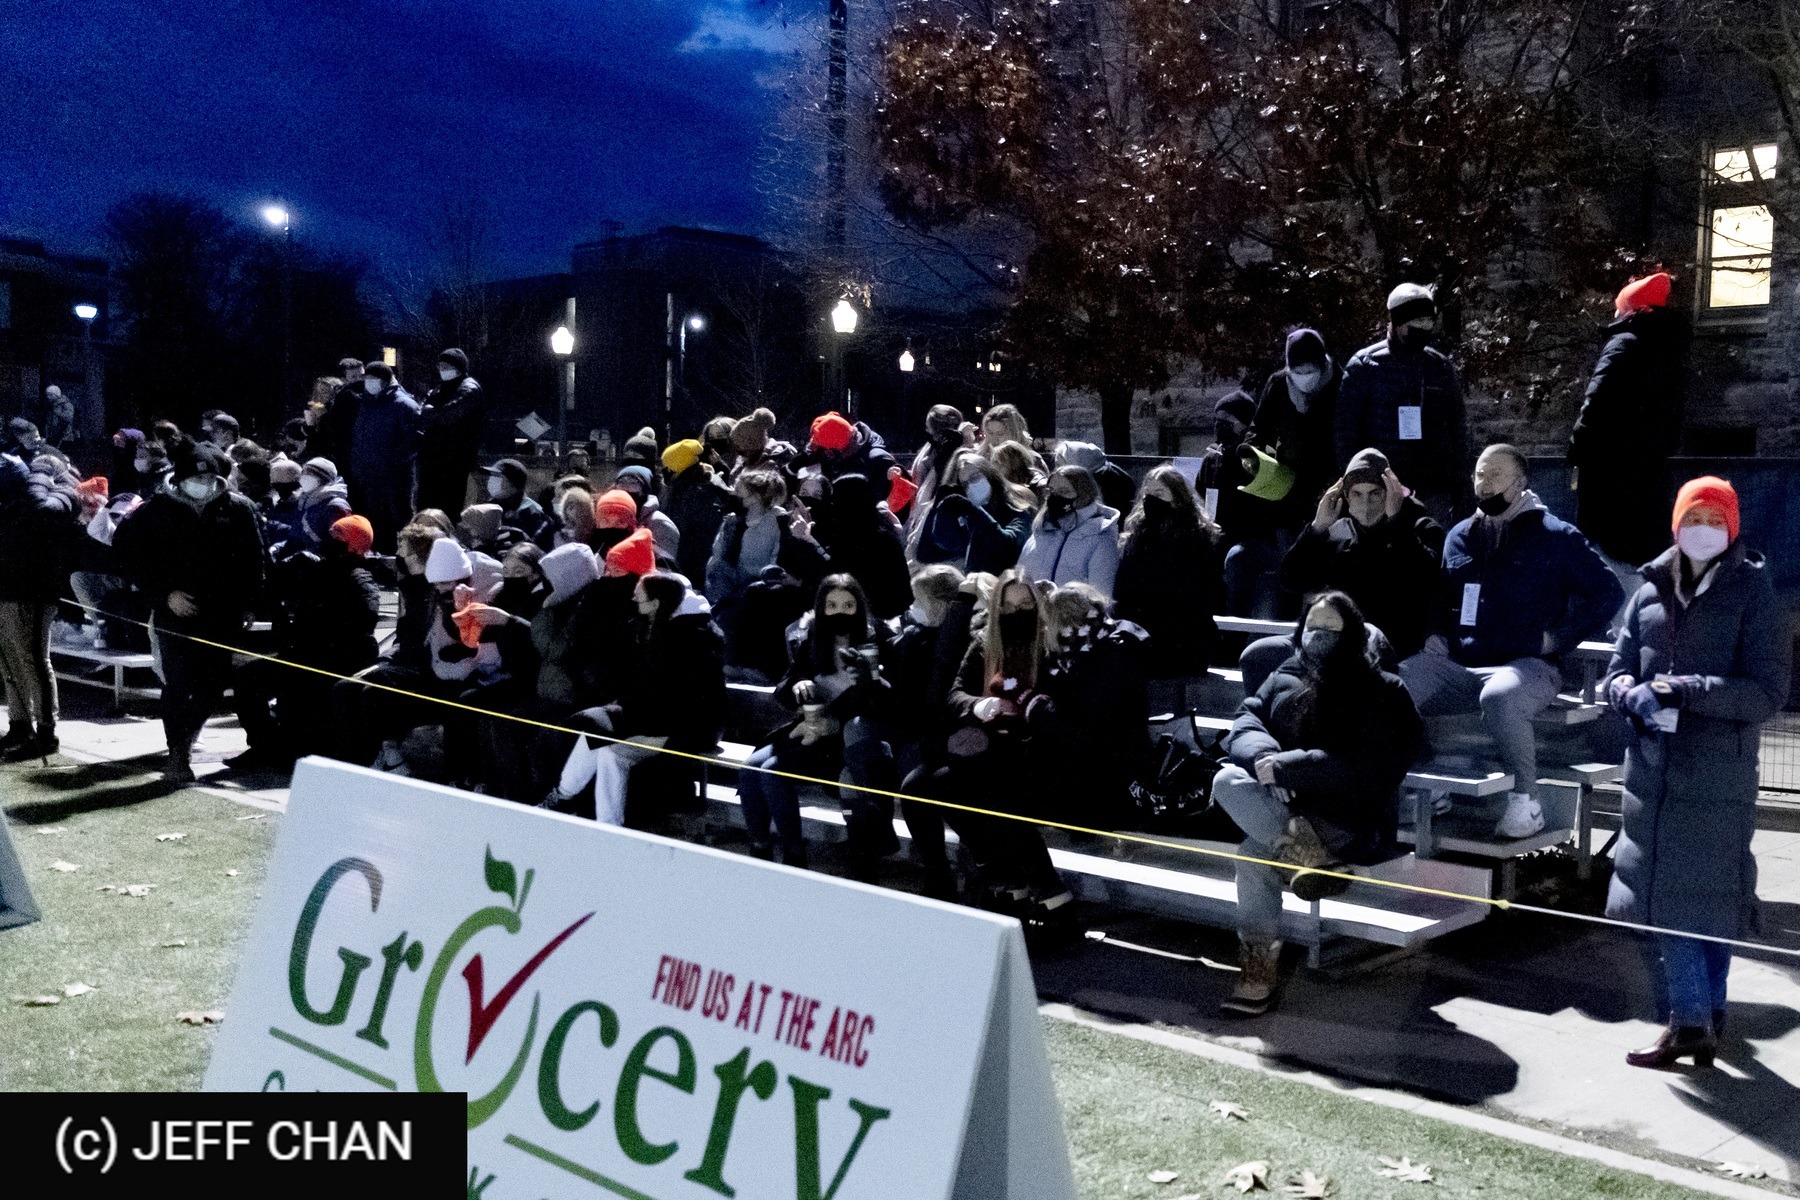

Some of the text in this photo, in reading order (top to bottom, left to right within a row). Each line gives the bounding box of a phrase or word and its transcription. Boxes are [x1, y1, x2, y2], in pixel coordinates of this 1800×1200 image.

[652, 954, 875, 1069] FIND US AT THE ARC
